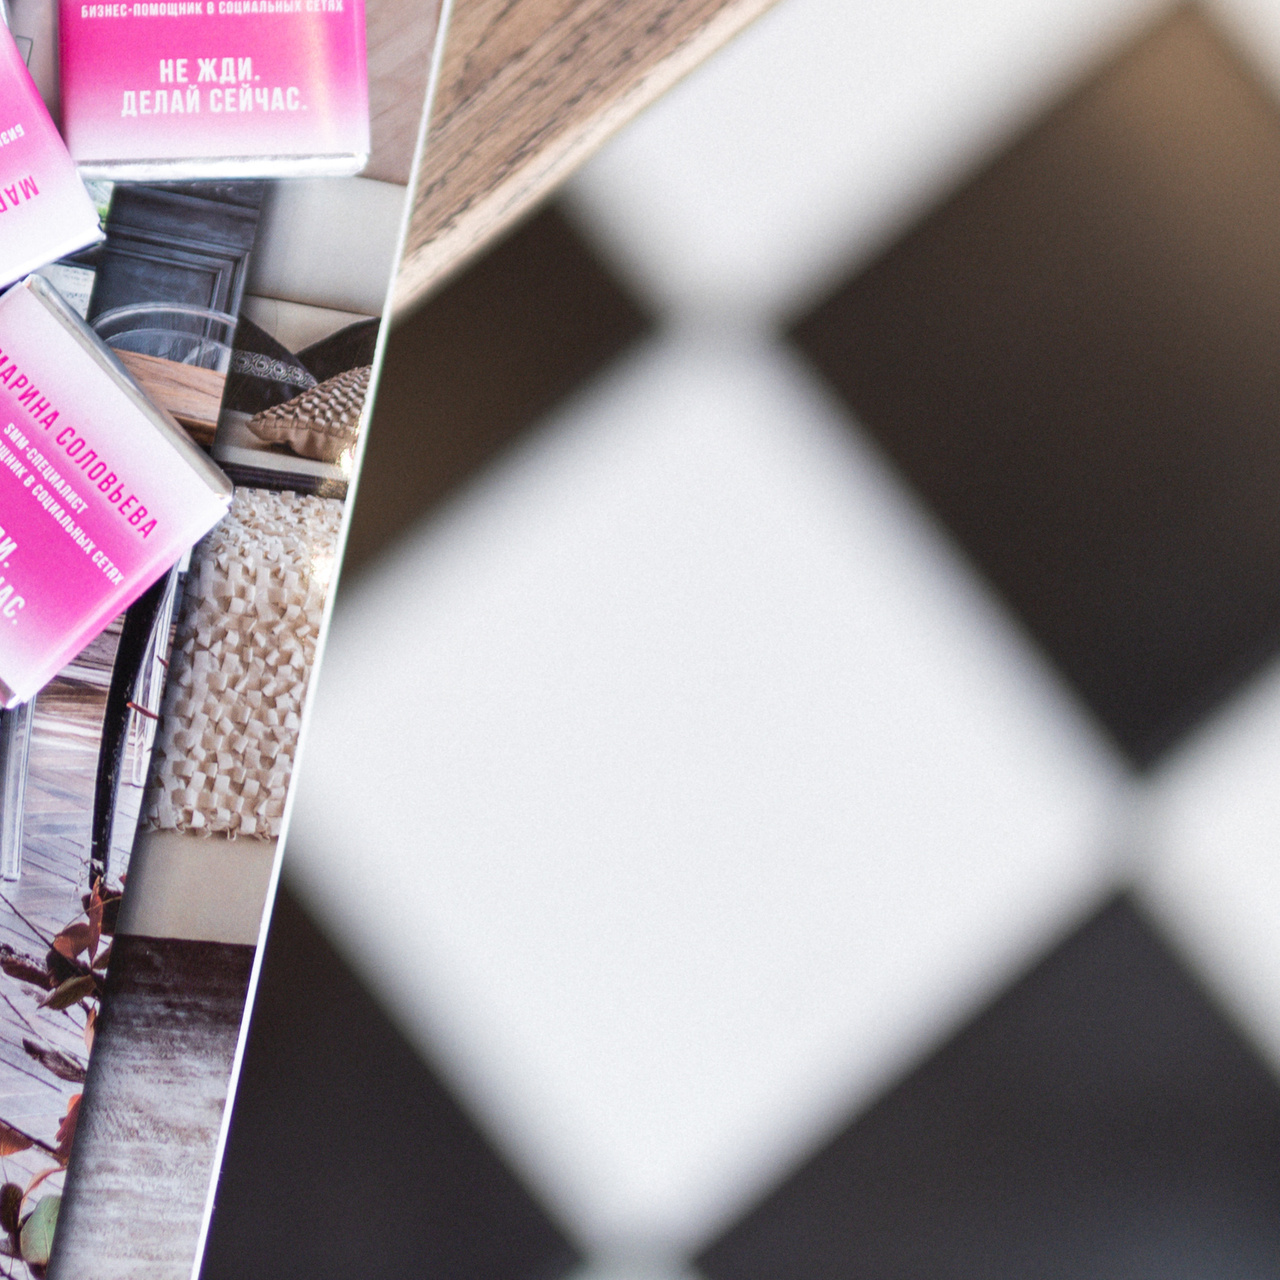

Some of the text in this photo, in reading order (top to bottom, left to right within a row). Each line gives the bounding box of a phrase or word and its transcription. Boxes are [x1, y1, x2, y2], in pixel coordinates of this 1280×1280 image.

[80, 0, 343, 18] БИЗНЕС-ПОМОЩНИК В СОЦИАЛЬНЫХ СЕТЯХ
[120, 84, 308, 116] ДЕЛАЙ СЕЙЧАС.
[159, 56, 260, 84] НЕ ЖДИ.
[1, 421, 89, 515] SMM-СПЕЦИАЛИСТ
[53, 425, 160, 539] СОЛОВЬЕВА
[21, 474, 36, 488] В
[29, 483, 96, 554] СОЦИАЛЬНЫХ
[89, 549, 125, 586] СЕТЯХ
